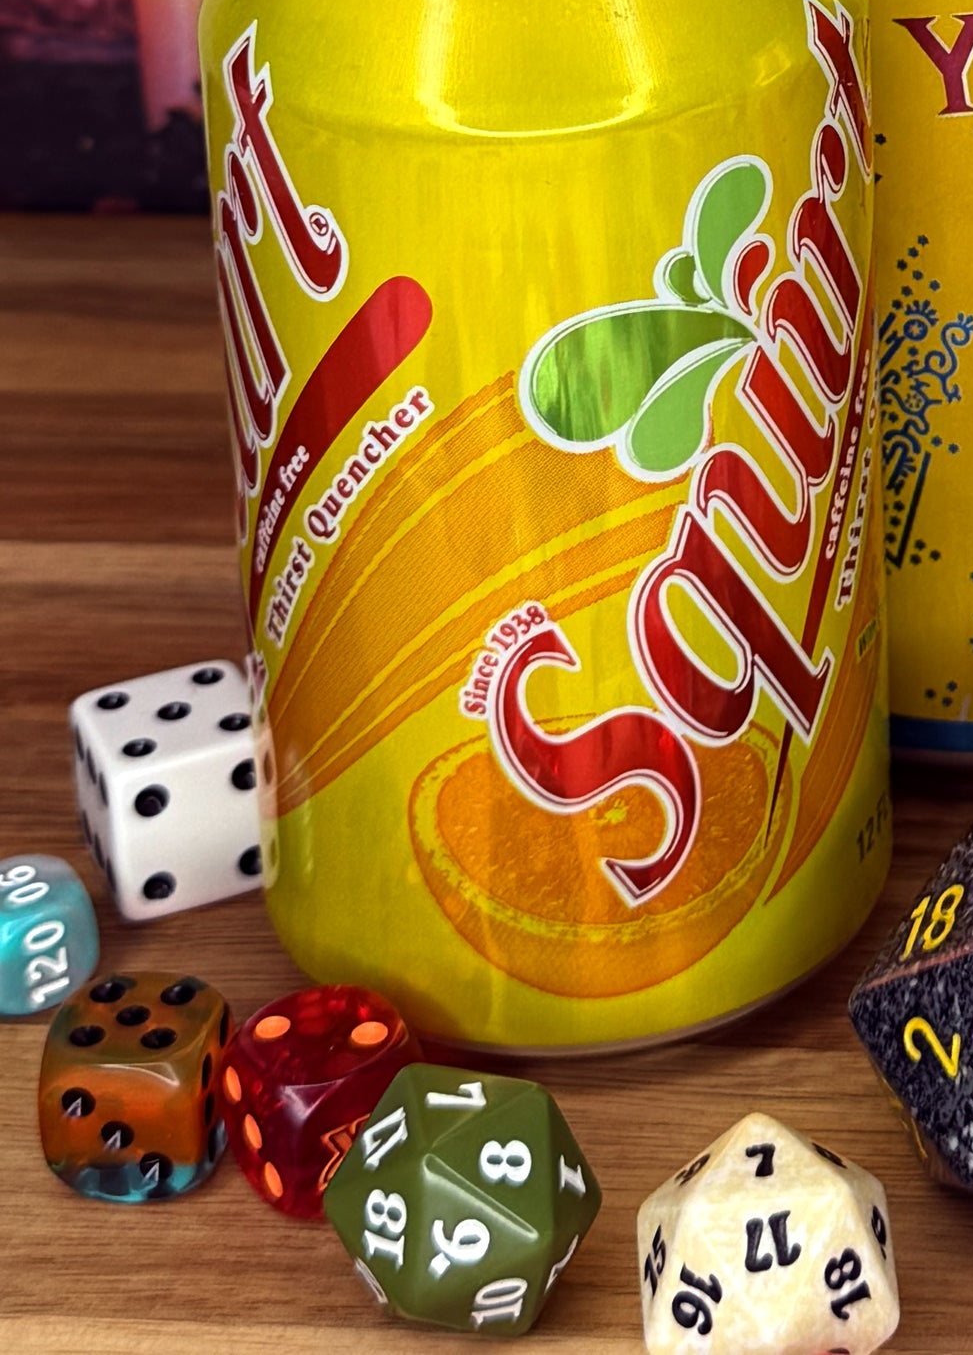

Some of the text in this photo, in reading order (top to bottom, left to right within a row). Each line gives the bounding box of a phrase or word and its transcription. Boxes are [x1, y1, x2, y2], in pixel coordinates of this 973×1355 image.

[277, 445, 311, 493] free
[266, 388, 431, 645] Thirst Quencher
[463, 605, 545, 715] Since 1938
[901, 884, 964, 961] 18
[24, 920, 70, 1005] 120
[903, 1016, 961, 1080] 2
[479, 1139, 532, 1187] 8
[745, 1142, 776, 1177] 7
[362, 1188, 407, 1273] 18
[744, 1210, 802, 1273] 17
[470, 1277, 528, 1331] 10
[671, 1261, 723, 1335] 16
[824, 1247, 872, 1321] 18
